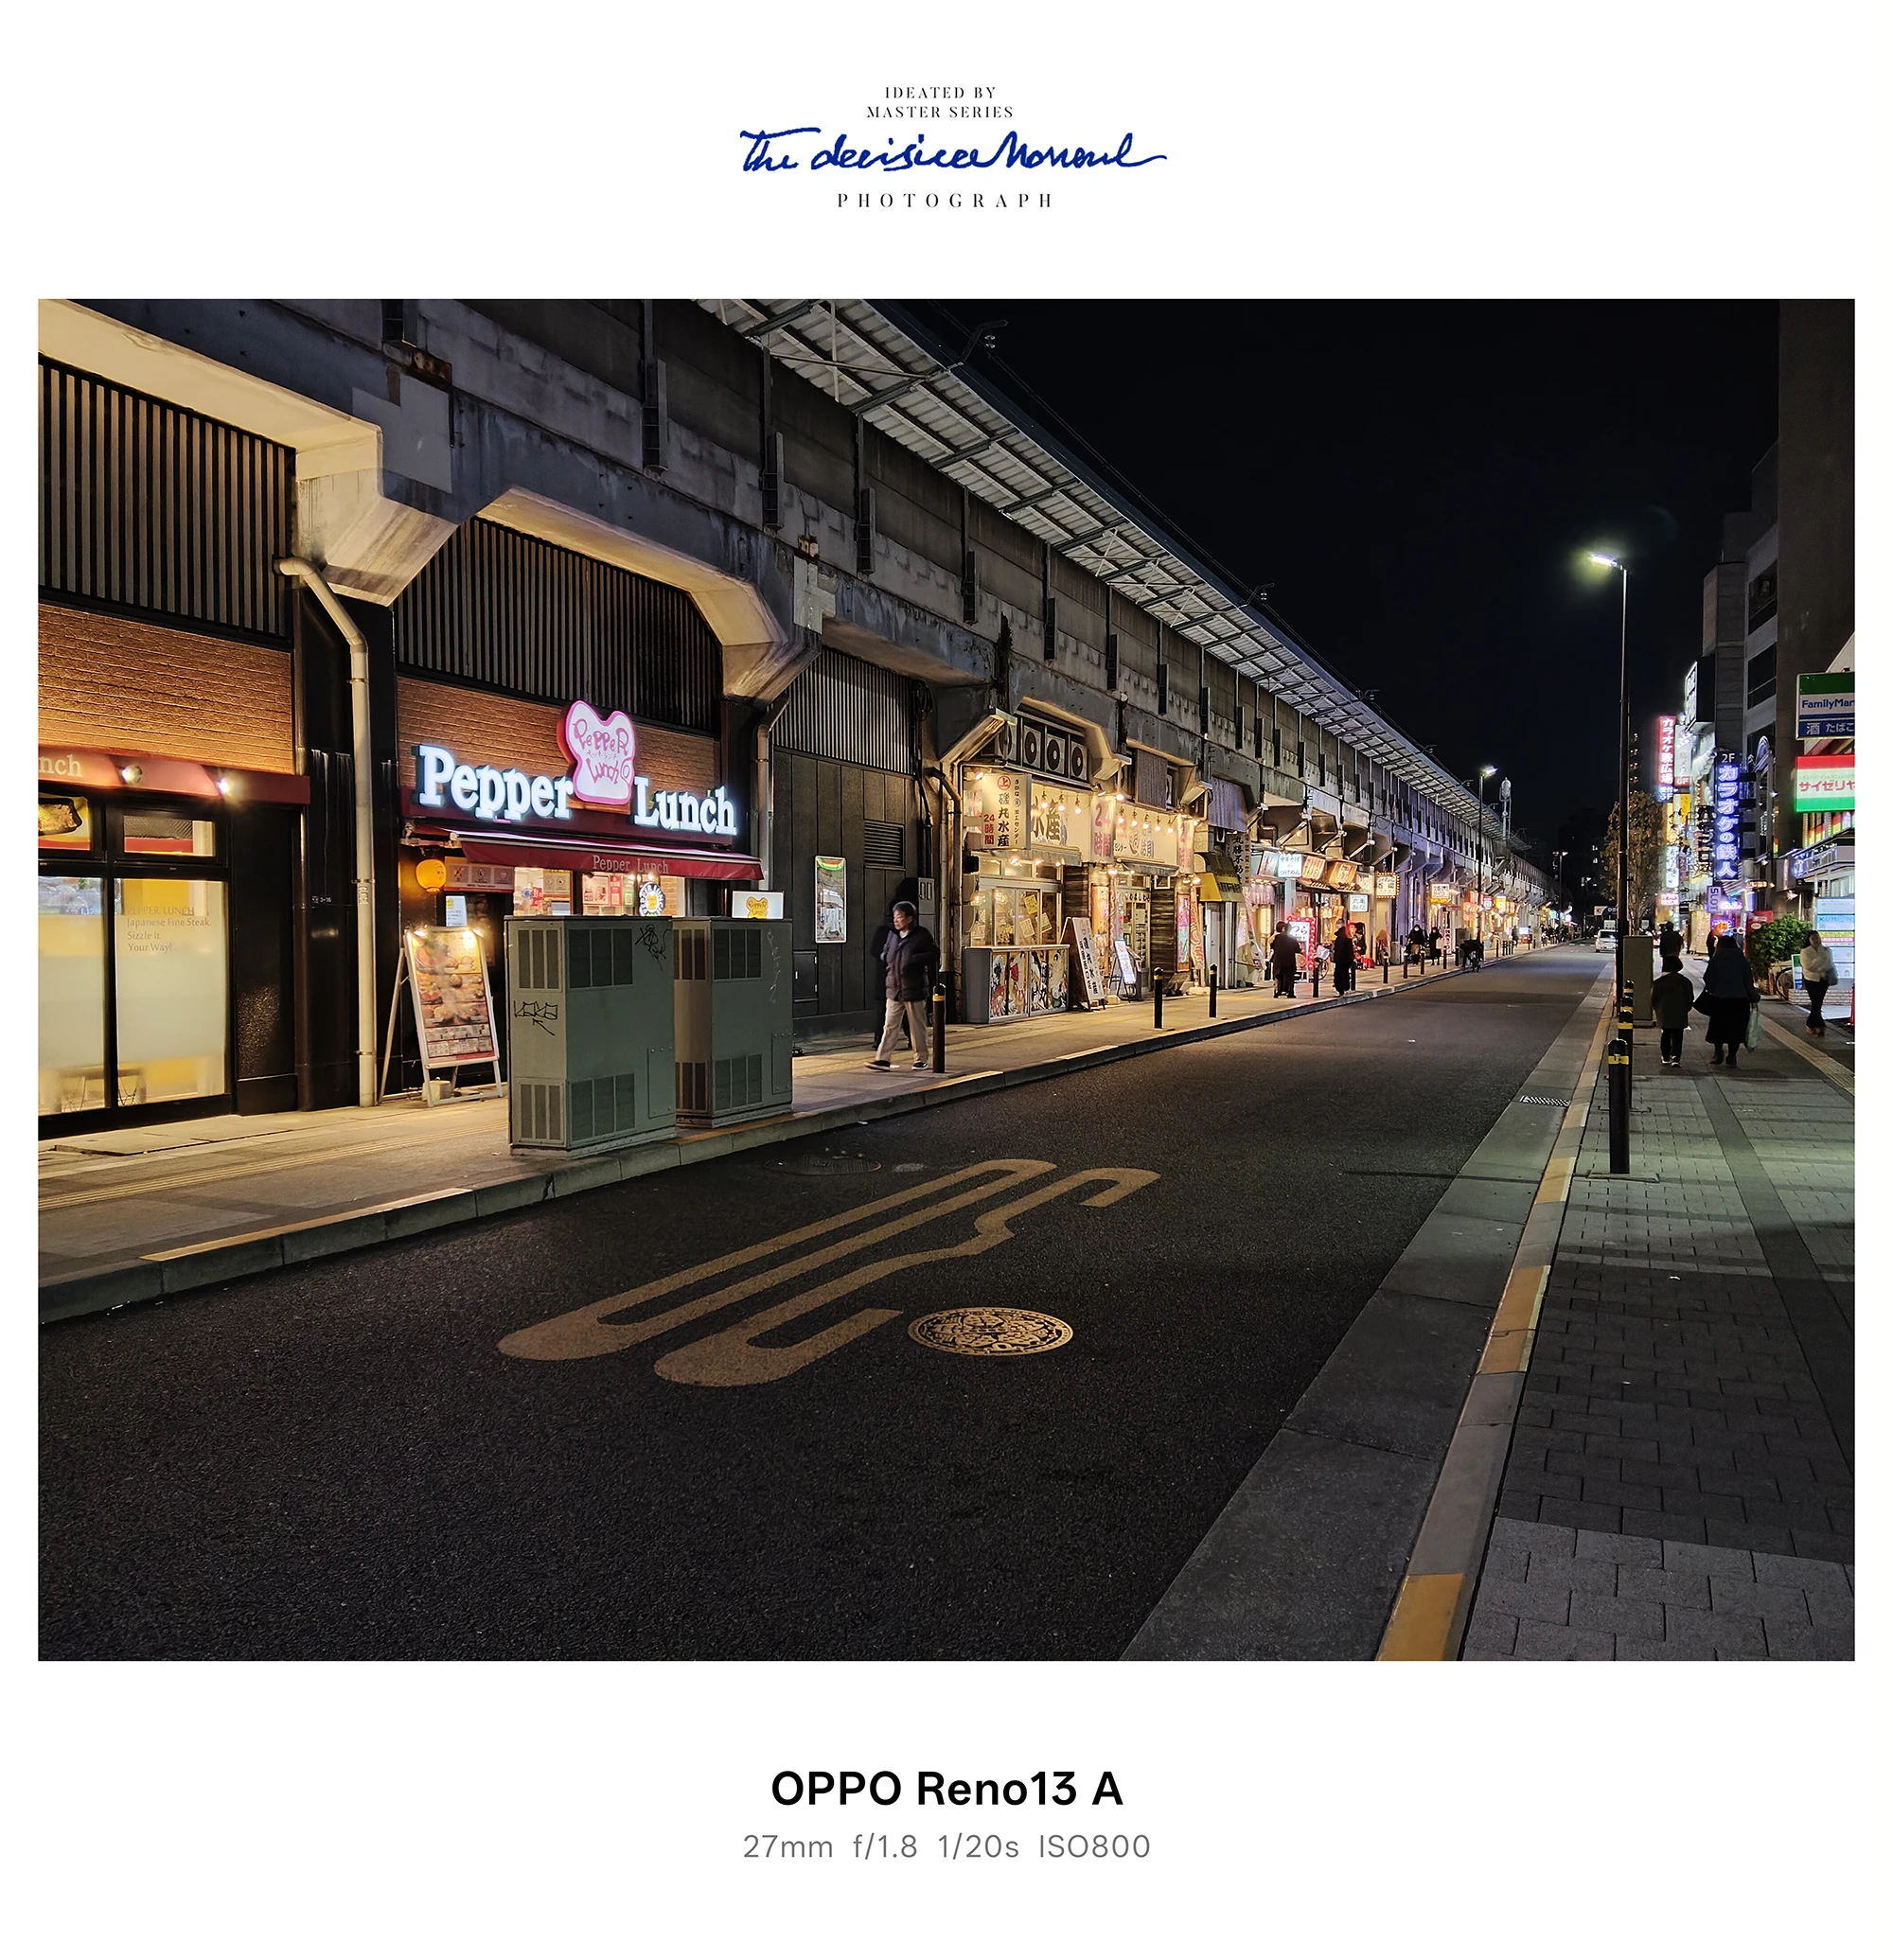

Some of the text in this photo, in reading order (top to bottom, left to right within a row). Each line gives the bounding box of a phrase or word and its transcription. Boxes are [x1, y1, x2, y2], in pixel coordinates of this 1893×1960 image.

[1806, 722, 1820, 735] 酒
[1721, 753, 1735, 763] 2F
[417, 745, 737, 836] Pepper Lunch
[998, 792, 1010, 847] 磯丸水産
[1717, 765, 1739, 878] カラオケの鉄人
[593, 855, 669, 874] Pepper Lunch
[1710, 887, 1719, 911] SLOT
[163, 906, 195, 916] LUNCH
[127, 918, 166, 928] Japanese
[168, 918, 185, 927] Fine
[127, 930, 152, 940] Sizzle
[128, 943, 149, 952] Your
